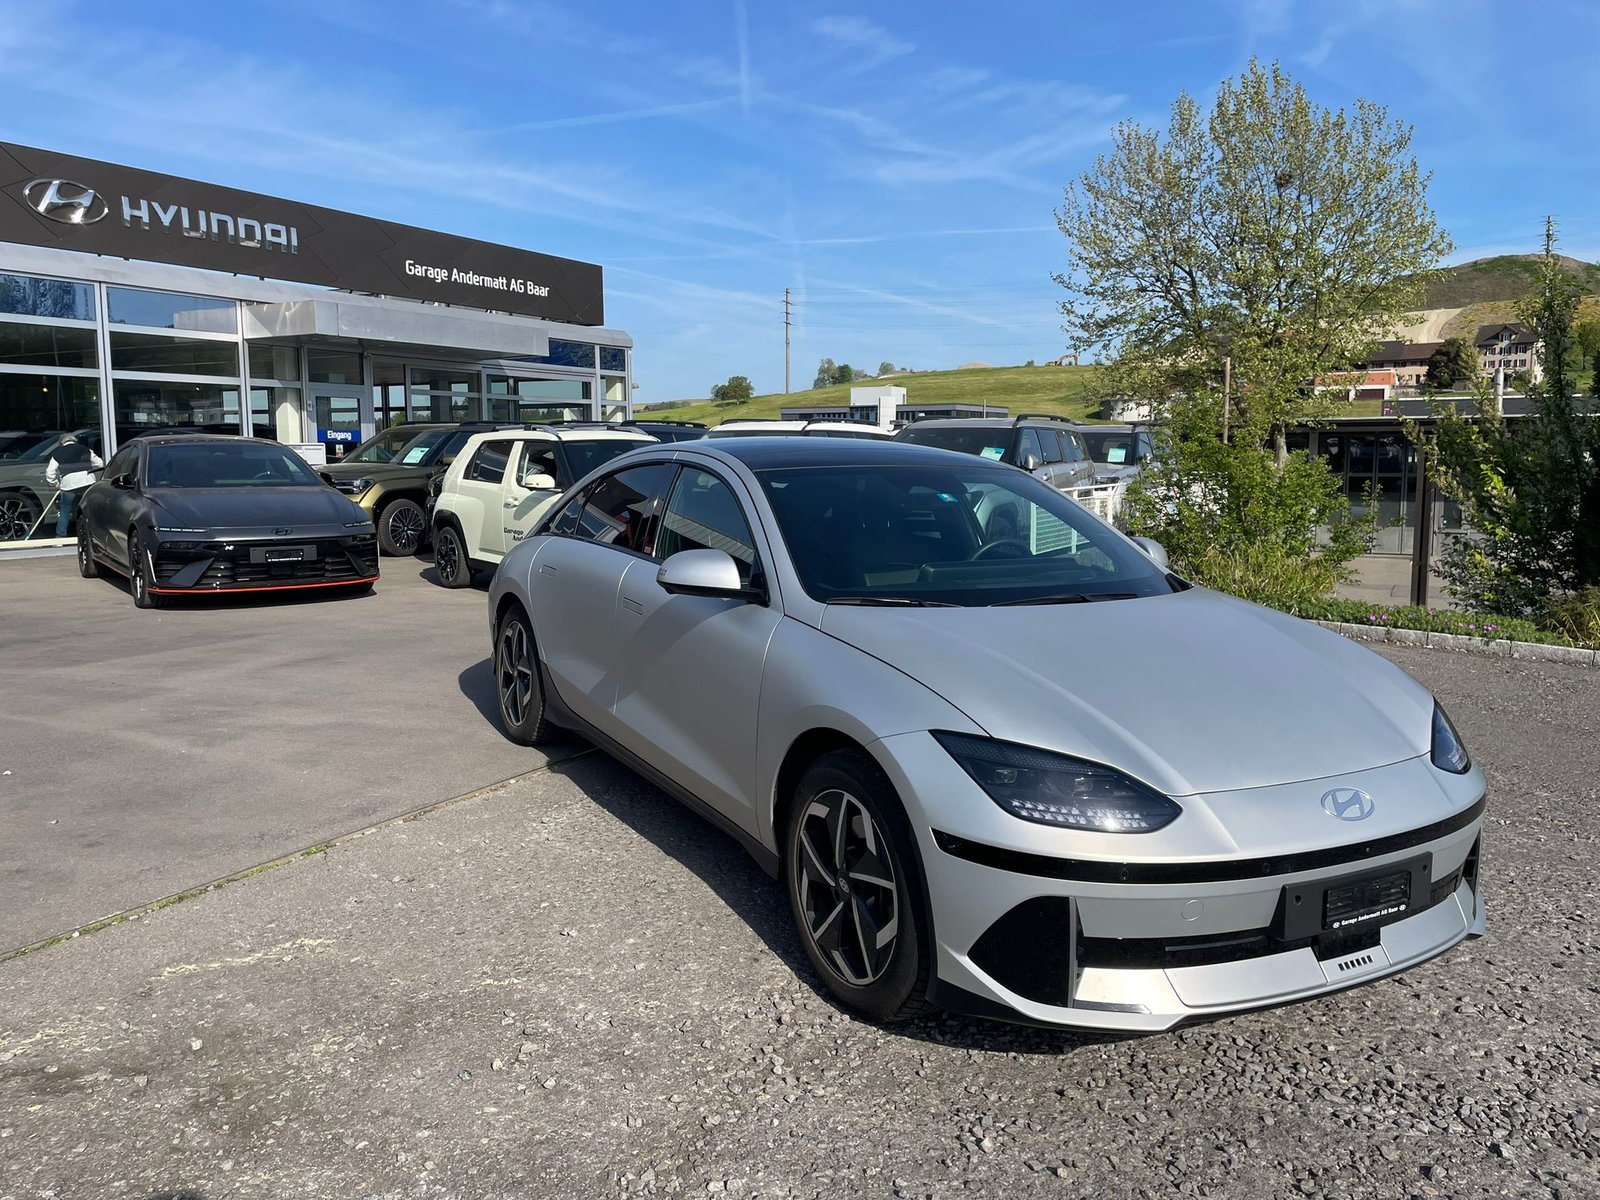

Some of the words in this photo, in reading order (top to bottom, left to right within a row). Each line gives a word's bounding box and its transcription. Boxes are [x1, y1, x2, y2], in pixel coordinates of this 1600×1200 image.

[121, 195, 298, 255] HYUNDAI
[405, 259, 448, 283] Garage
[451, 268, 508, 291] Andermatt
[510, 278, 524, 293] AG
[526, 281, 550, 297] Baar
[327, 430, 352, 440] Eingang
[1341, 918, 1357, 926] Garage
[1358, 911, 1380, 921] Andermatt
